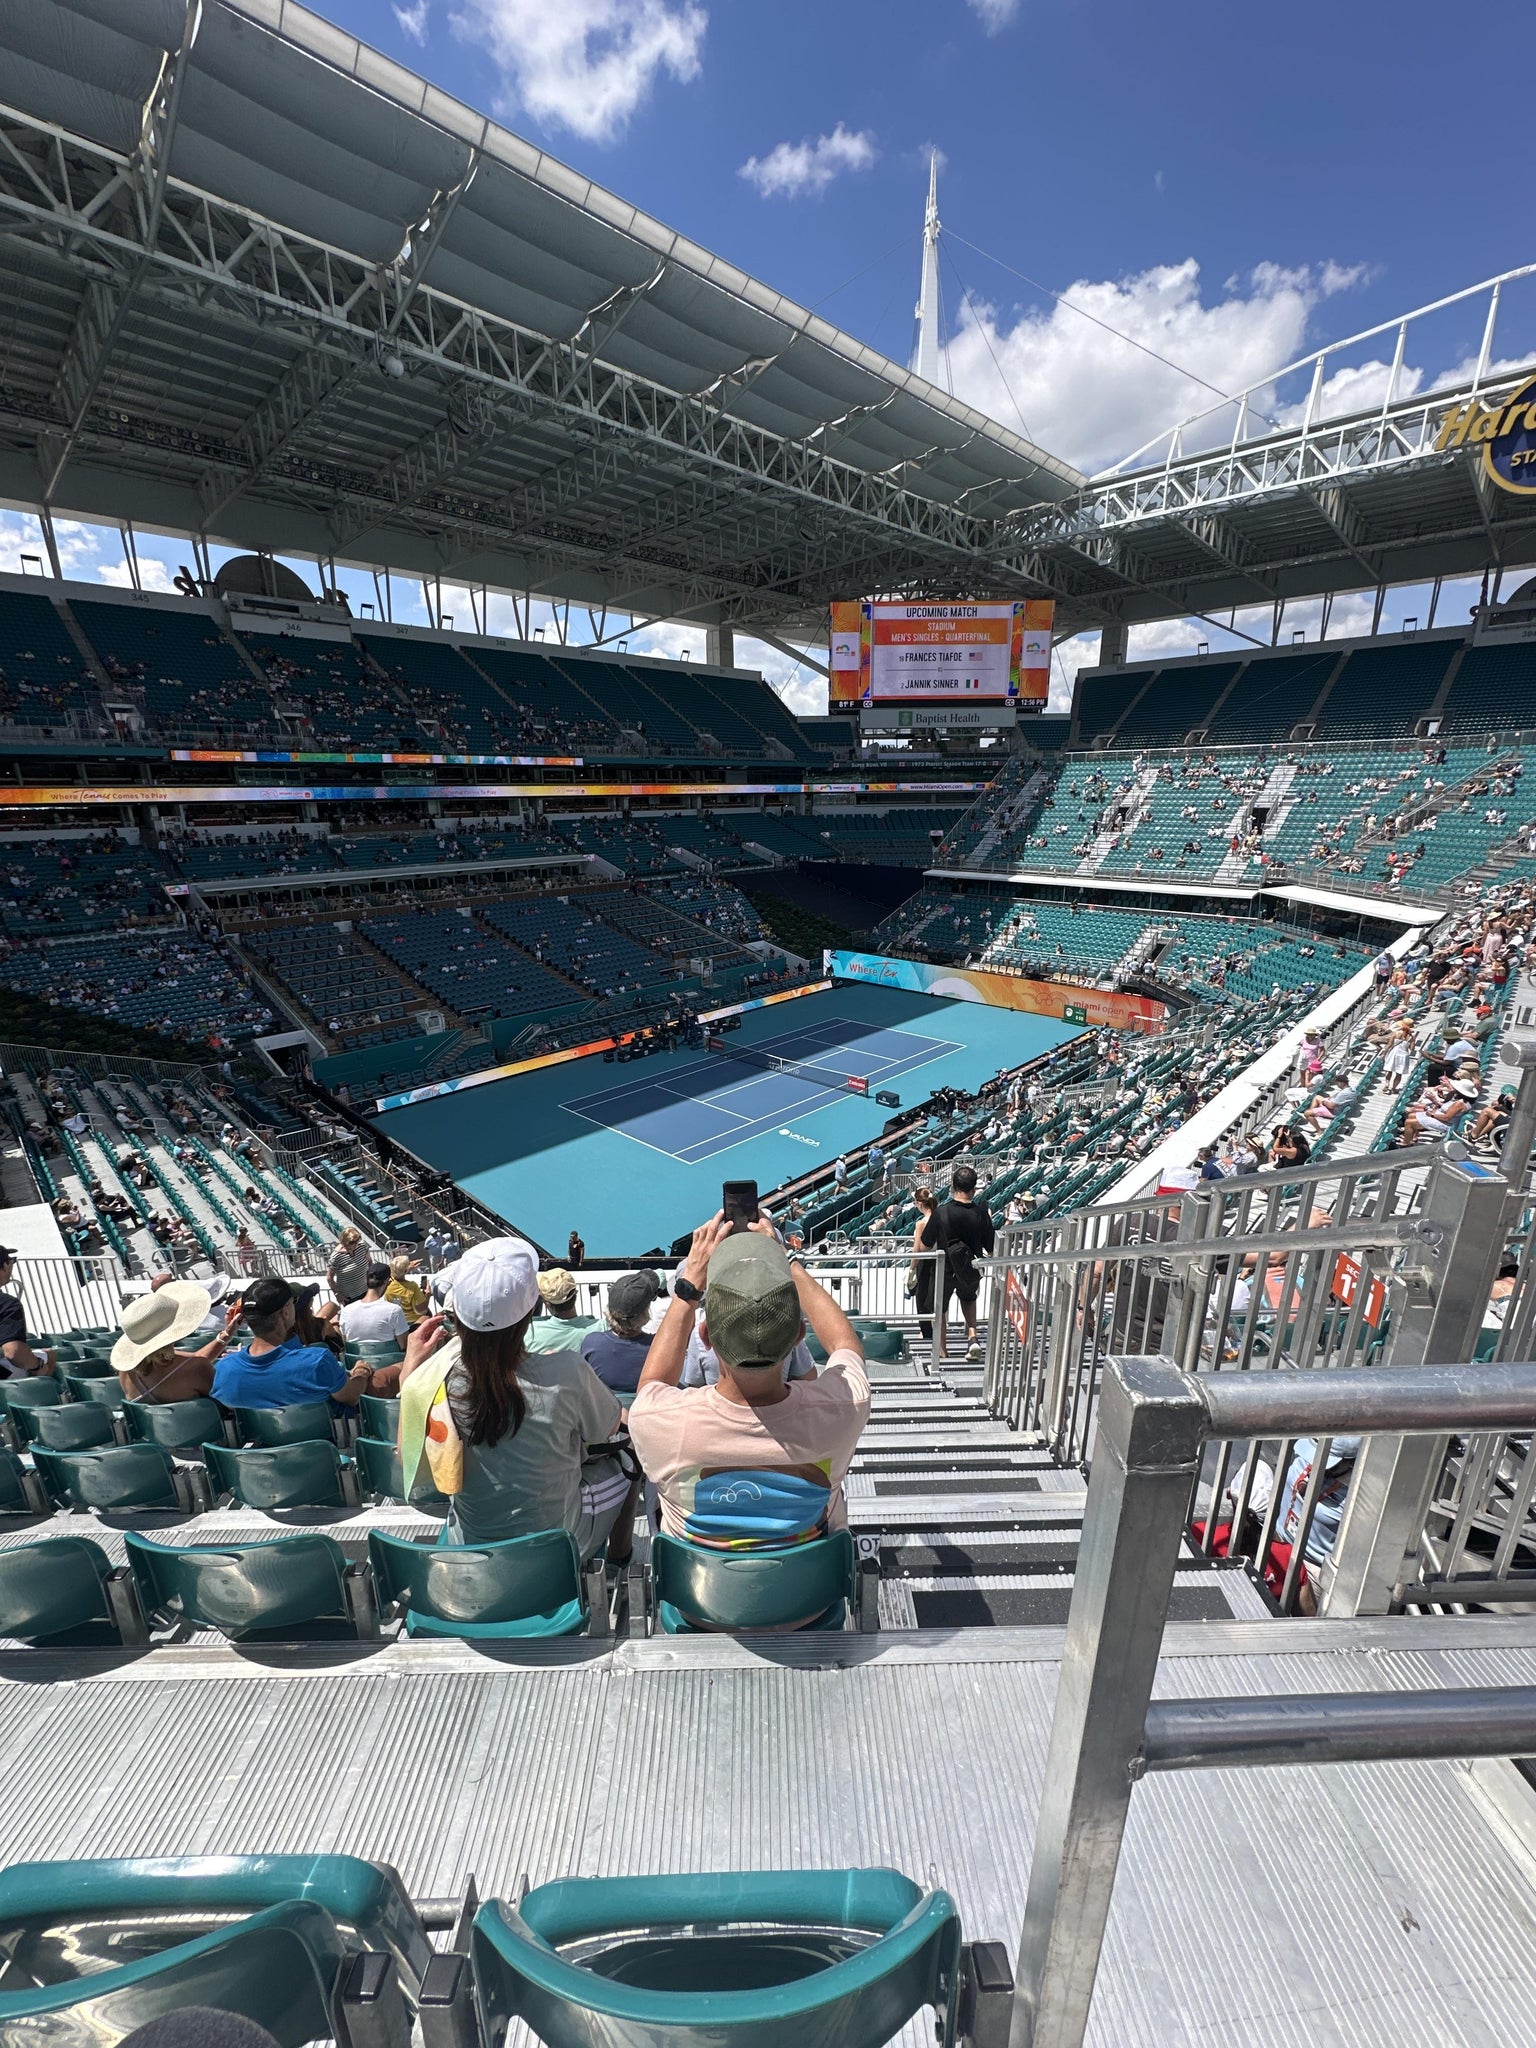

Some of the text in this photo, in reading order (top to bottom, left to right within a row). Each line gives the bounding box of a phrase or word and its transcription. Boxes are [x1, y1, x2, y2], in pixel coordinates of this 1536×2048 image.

[131, 593, 150, 603] 345
[906, 607, 978, 618] UPCOMING MATCH
[285, 622, 302, 632] 346
[927, 622, 956, 631] STADIUM
[891, 633, 912, 642] MEN'S
[912, 633, 939, 642] SINGLES
[945, 633, 991, 642] QUARTERFINAL
[905, 653, 937, 662] FRANCES
[939, 652, 963, 662] TIAFOE
[905, 679, 931, 689] JANNIK
[932, 679, 959, 688] SINNER
[915, 713, 980, 725] Baptist Health
[50, 793, 78, 801] Where
[72, 789, 112, 803] Tennis
[140, 792, 149, 800] To
[150, 792, 168, 801] Play
[849, 962, 878, 976] Where
[1073, 1001, 1125, 1015] miami open
[788, 1131, 821, 1148] VANDA
